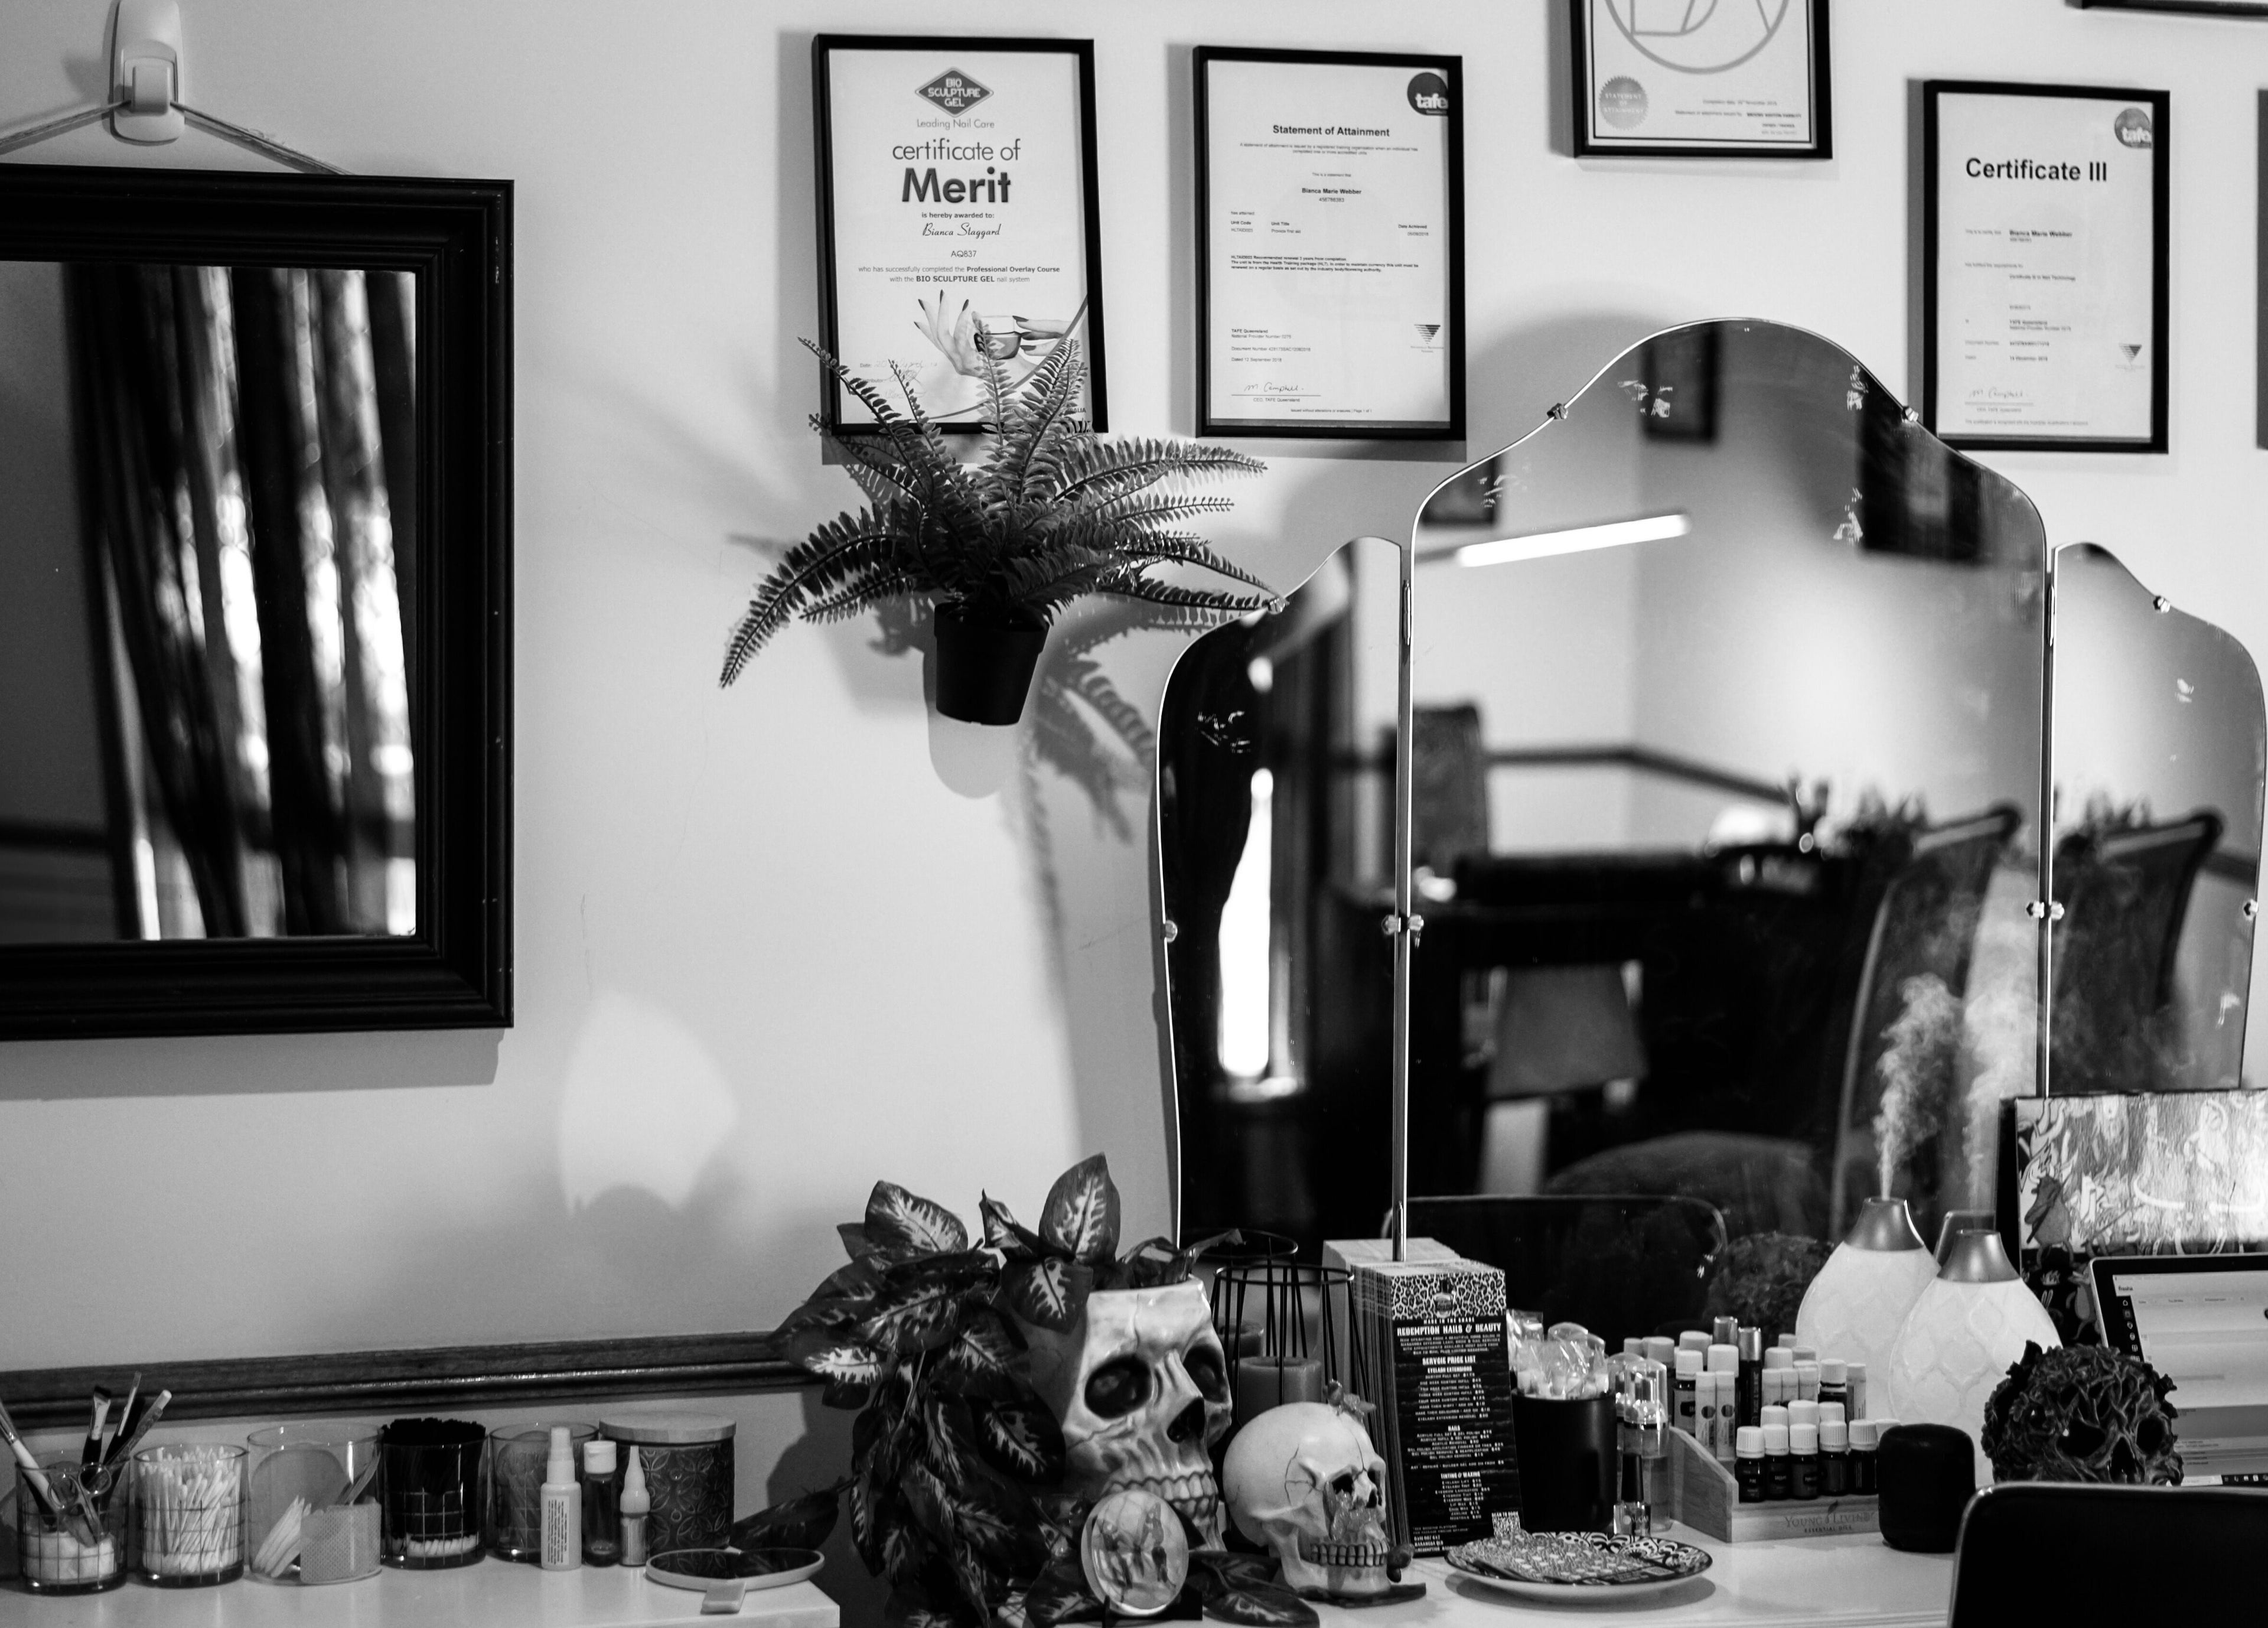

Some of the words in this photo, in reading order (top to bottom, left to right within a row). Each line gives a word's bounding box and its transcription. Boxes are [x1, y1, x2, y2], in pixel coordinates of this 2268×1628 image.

[946, 78, 962, 88] BIO
[927, 87, 980, 98] SCULPTURE
[944, 97, 964, 107] GEL
[1415, 93, 1448, 109] tafe
[917, 118, 950, 129] Leading
[953, 119, 971, 128] Nail
[973, 119, 995, 129] Care
[1273, 125, 1322, 135] Statement
[1325, 126, 1335, 135] of
[1337, 127, 1390, 136] Attainment
[892, 138, 993, 161] certificate
[1000, 138, 1021, 161] of
[1966, 158, 2081, 180] Certificate
[2090, 162, 2106, 181] III
[902, 167, 1011, 203] Merit
[922, 222, 953, 237] Bianca
[950, 250, 977, 258] AQ837
[1397, 1326, 1439, 1336] REDEMPTION
[1443, 1325, 1462, 1334] NAILS
[1465, 1324, 1472, 1333] &
[1475, 1323, 1501, 1333] BEAUTY
